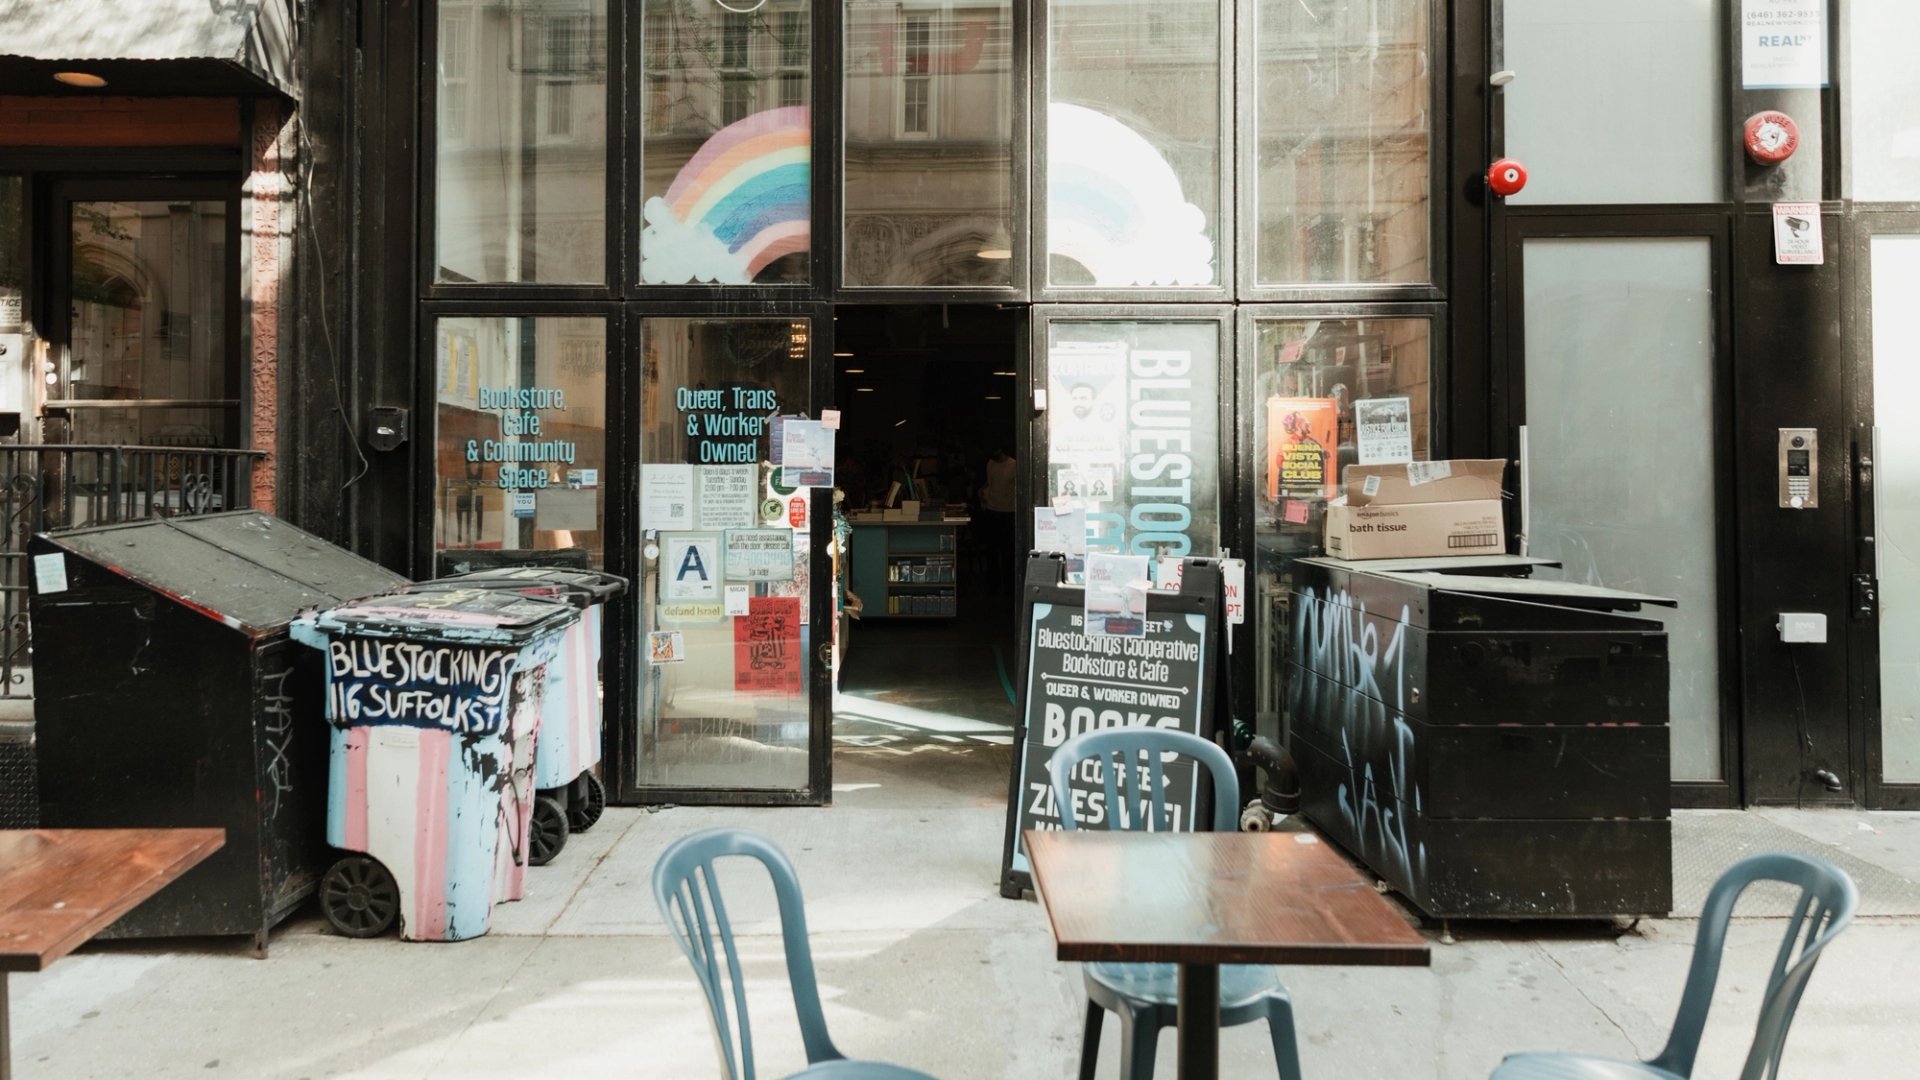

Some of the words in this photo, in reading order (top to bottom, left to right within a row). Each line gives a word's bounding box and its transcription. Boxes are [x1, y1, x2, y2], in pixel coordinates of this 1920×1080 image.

[1776, 206, 1817, 215] WARNING
[0, 298, 21, 307] TICE
[479, 386, 567, 410] Bookstore,
[676, 387, 727, 412] Queer,
[732, 387, 781, 412] Trans,
[503, 412, 543, 436] Cafe,
[686, 413, 700, 436] &
[704, 413, 765, 436] Worker
[466, 439, 479, 462] &
[484, 439, 576, 464] Community
[700, 438, 757, 463] Owned
[1282, 452, 1321, 461] VISTA
[498, 465, 548, 491] Space
[705, 476, 725, 484] Tuesday
[729, 476, 747, 484] Sunday
[1282, 471, 1322, 479] CLUB
[735, 534, 745, 542] you
[1349, 524, 1374, 532] bath
[1377, 523, 1407, 532] tissue
[763, 542, 780, 550] please
[676, 545, 708, 581] A
[664, 606, 695, 616] defund
[697, 606, 720, 616] Israel
[1070, 614, 1083, 627] 116
[1038, 628, 1122, 657] Bluestockings
[1123, 636, 1199, 662] Cooperative
[329, 640, 518, 703] BLUESTOCKINGS
[1062, 653, 1125, 678] Bookstore
[1127, 659, 1138, 679] &
[1139, 661, 1169, 682] Cafe
[331, 682, 364, 723] 116
[364, 685, 472, 730] SUFFOLK
[468, 704, 500, 732] ST
[1046, 682, 1079, 699] QUEER
[1081, 686, 1090, 700] &
[1093, 687, 1138, 705] WORKER
[1139, 692, 1181, 709] OWNED
